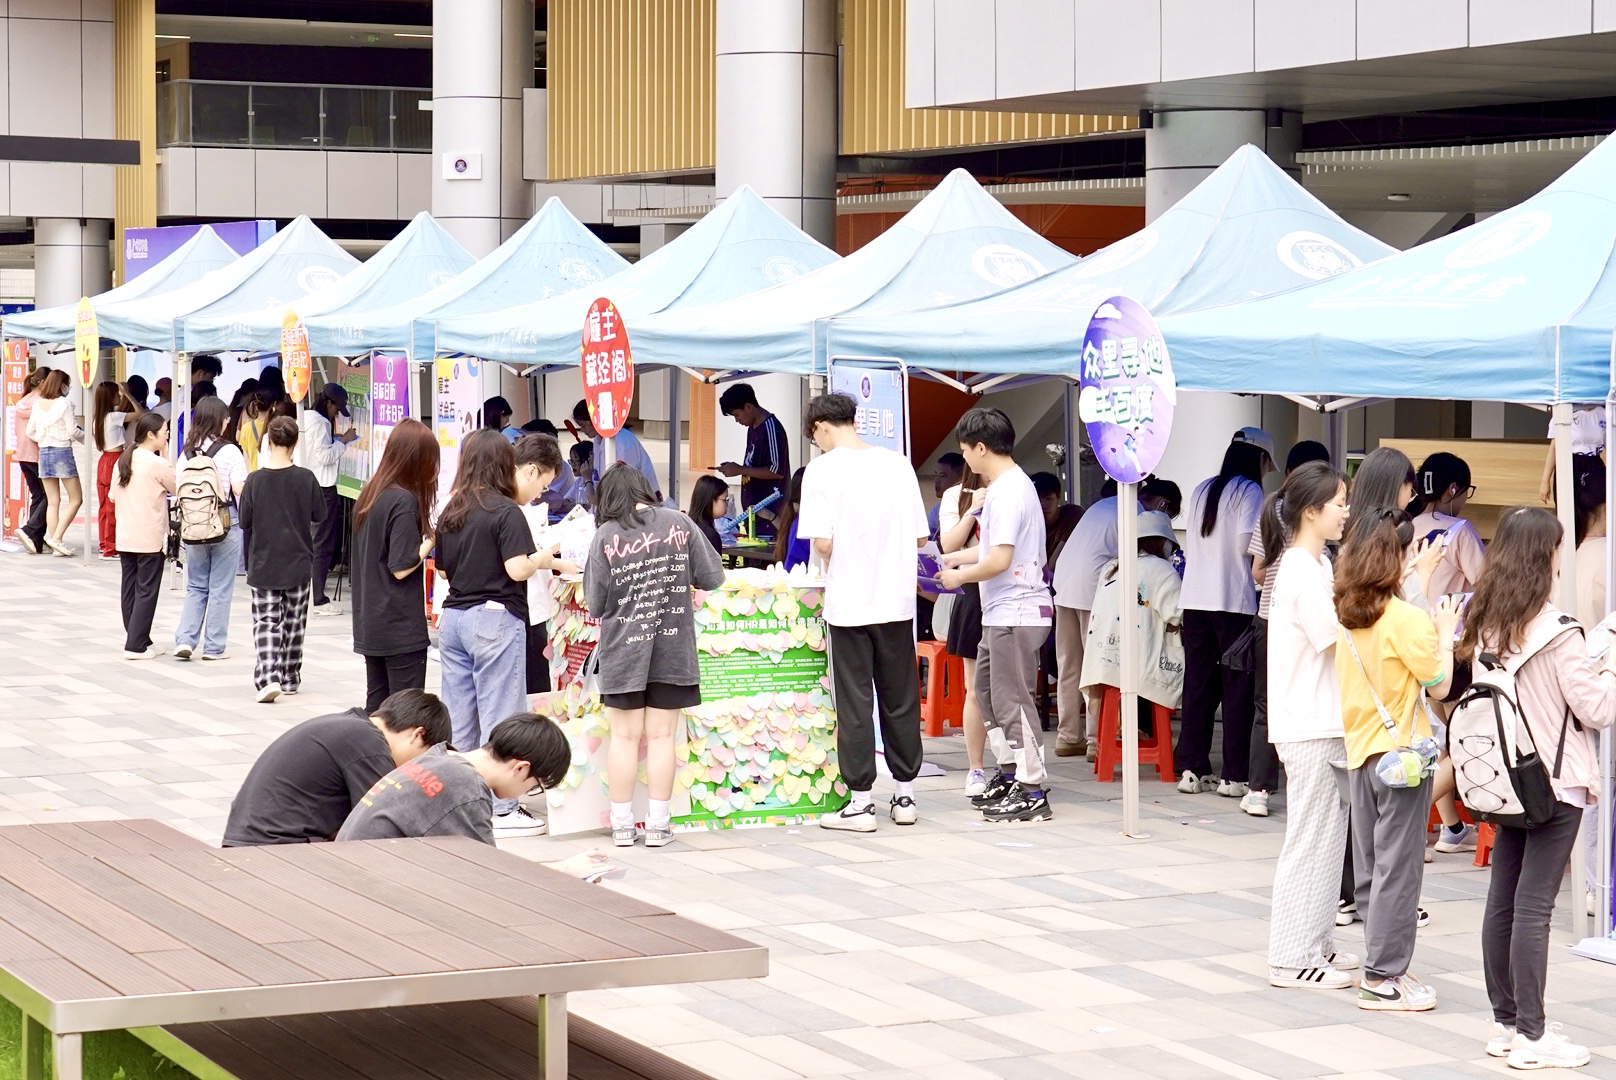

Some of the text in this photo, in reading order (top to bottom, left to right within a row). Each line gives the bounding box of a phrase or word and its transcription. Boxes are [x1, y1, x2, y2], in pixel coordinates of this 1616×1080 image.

[589, 308, 617, 342] 雇主
[1083, 334, 1164, 382] 众里寻他
[585, 349, 627, 387] 藏经阁
[379, 404, 404, 423] 打卡日记
[615, 575, 632, 587] Late
[625, 634, 645, 644] Jesus
[615, 831, 632, 840] NIKE
[646, 832, 662, 840] NIKE
